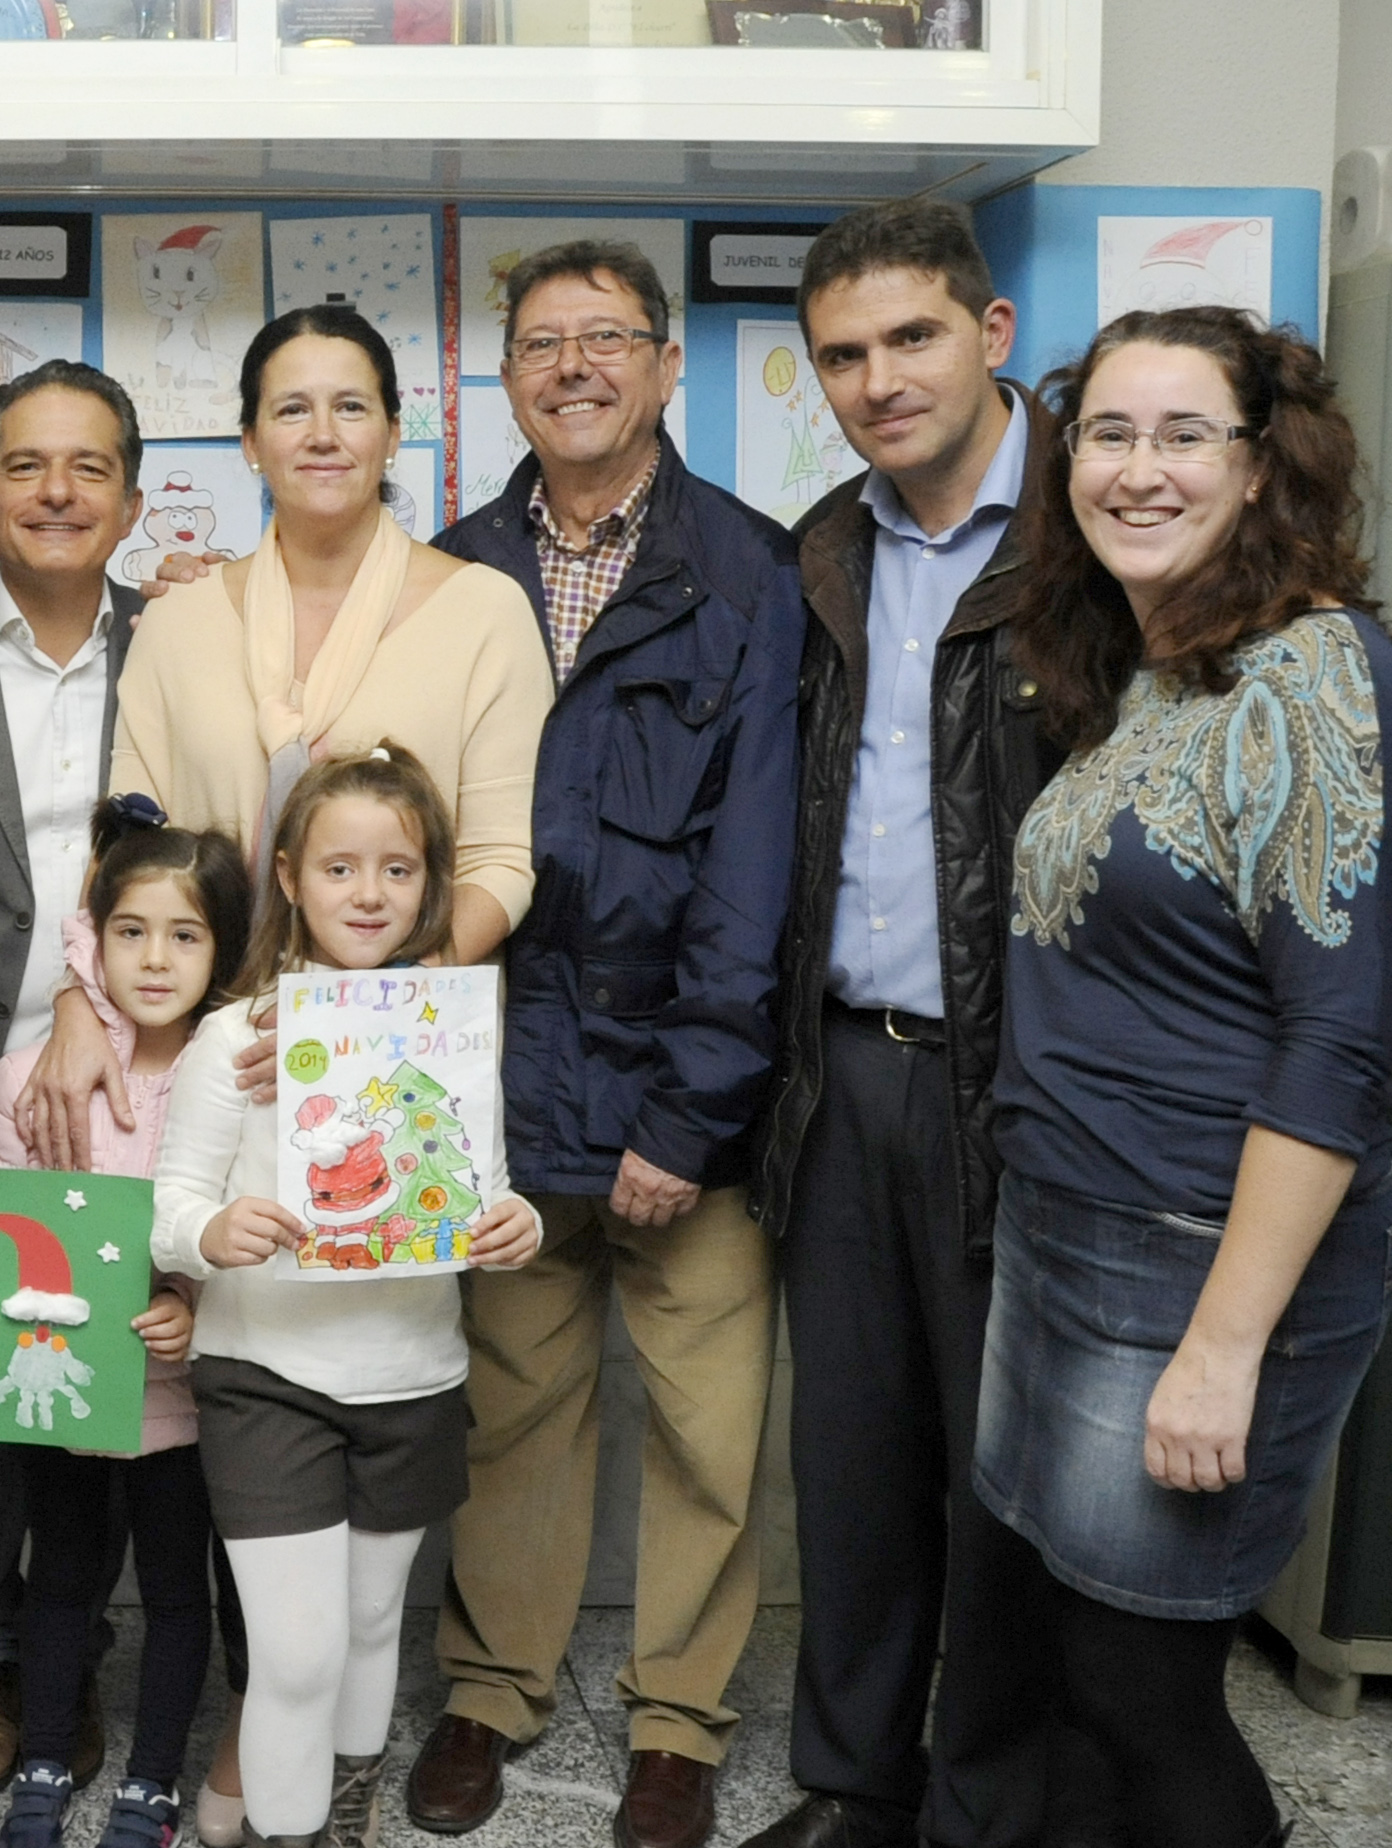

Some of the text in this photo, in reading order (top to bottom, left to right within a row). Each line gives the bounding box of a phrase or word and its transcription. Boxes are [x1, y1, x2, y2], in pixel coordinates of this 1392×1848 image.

[15, 246, 55, 261] AÑOS
[723, 255, 805, 268] JUVENIL DE
